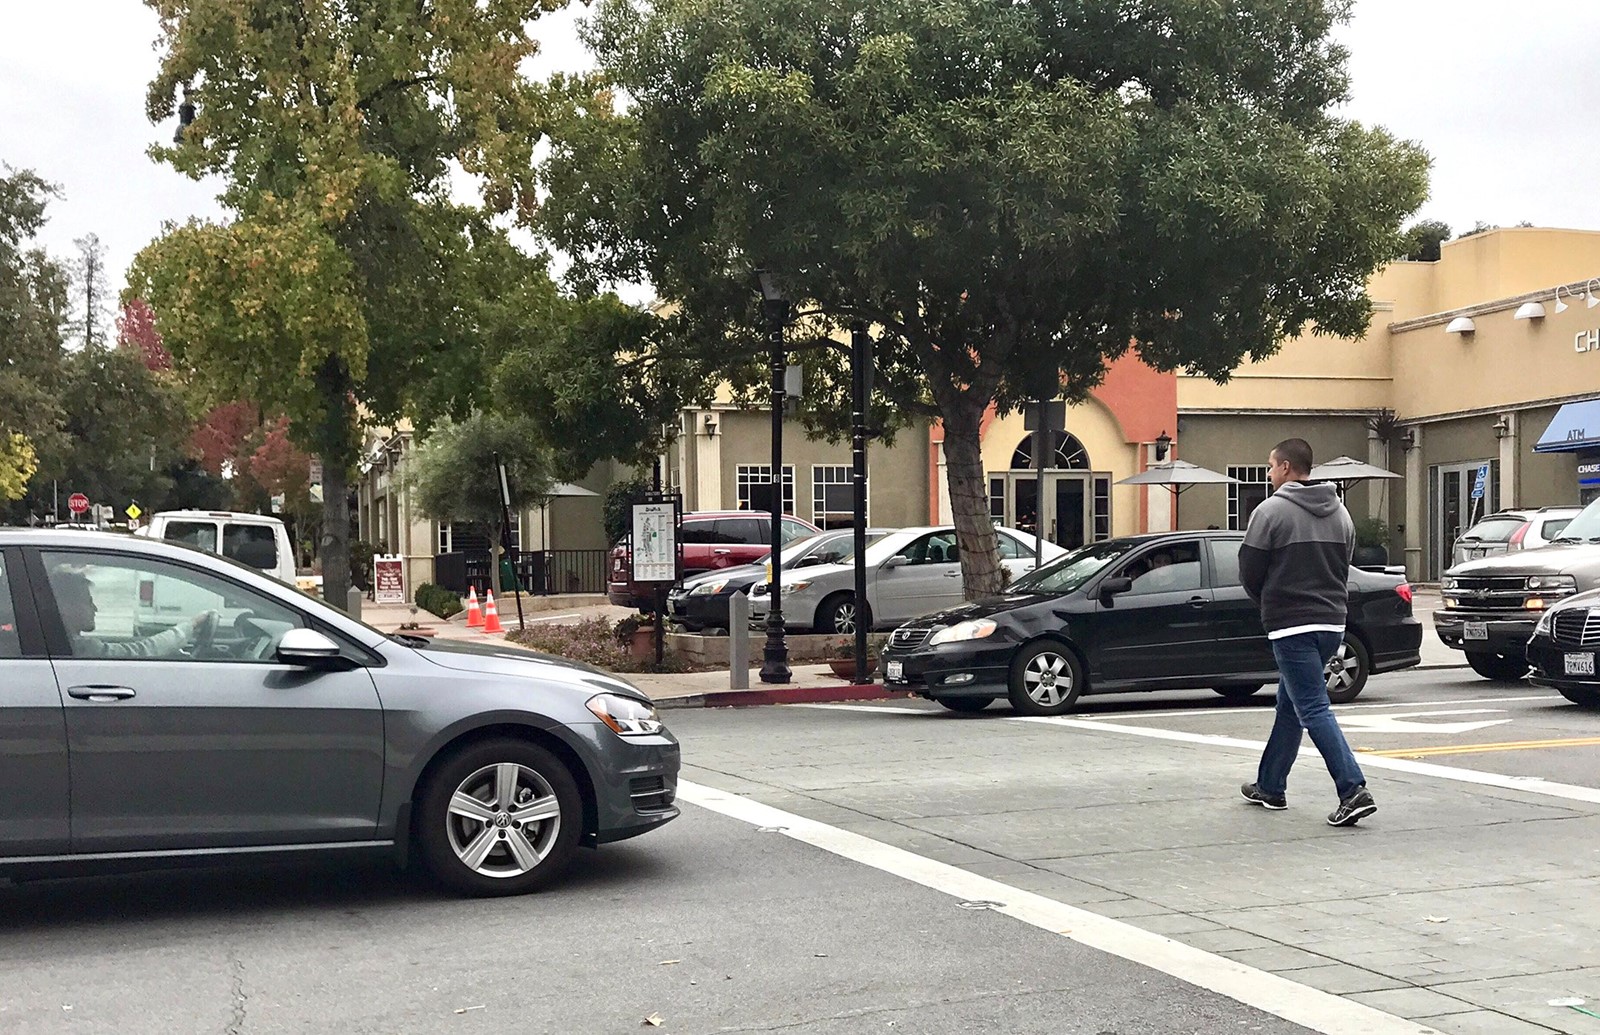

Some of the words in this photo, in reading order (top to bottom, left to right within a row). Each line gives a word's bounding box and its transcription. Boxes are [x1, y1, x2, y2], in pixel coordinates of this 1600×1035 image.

[1575, 329, 1599, 352] CH
[1567, 428, 1585, 442] ATM
[1577, 464, 1600, 473] CHASE
[70, 499, 88, 507] STOP
